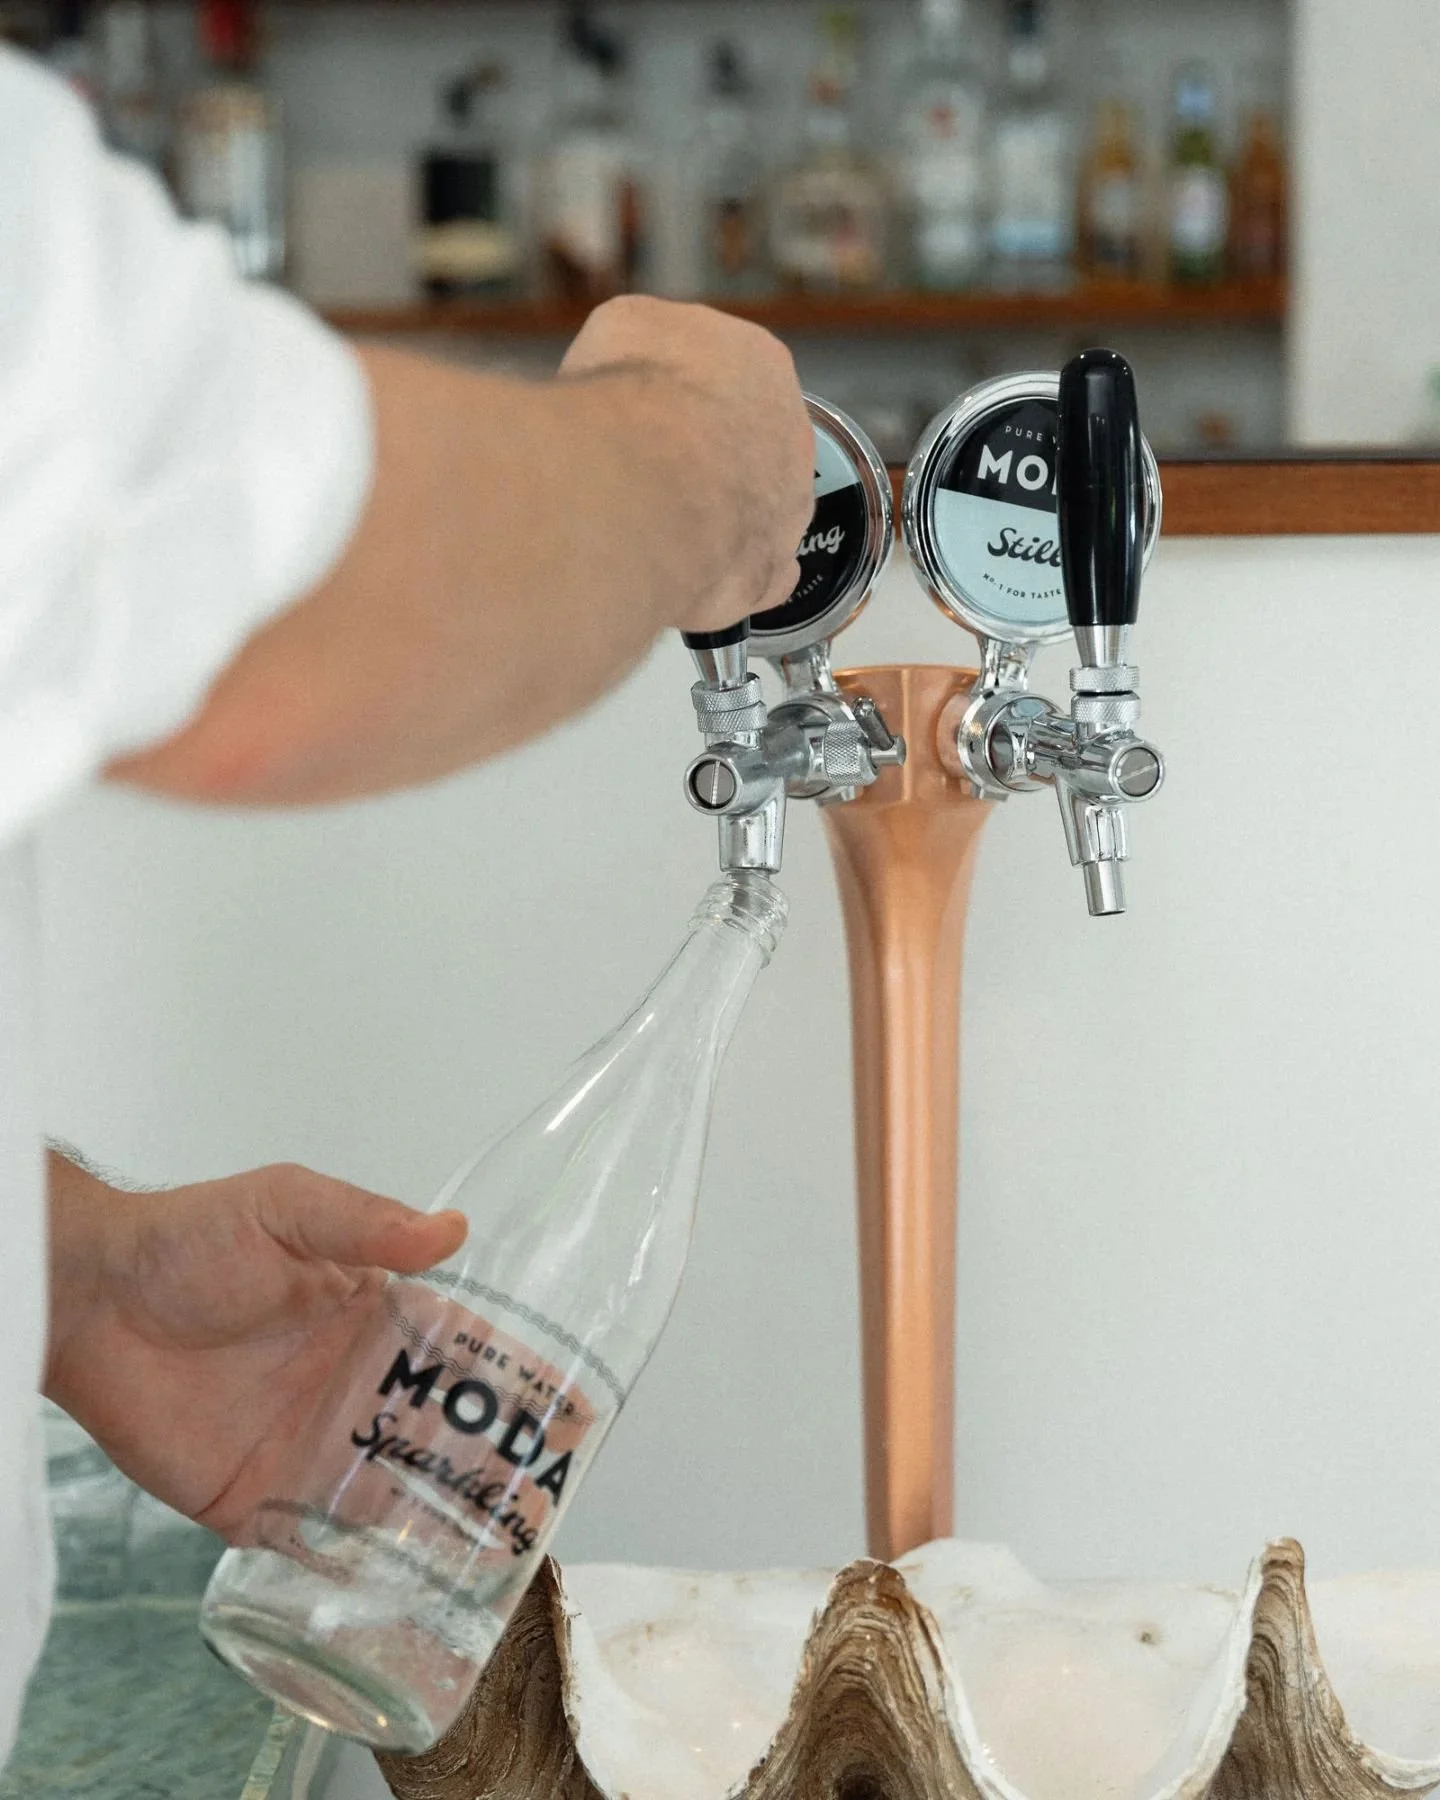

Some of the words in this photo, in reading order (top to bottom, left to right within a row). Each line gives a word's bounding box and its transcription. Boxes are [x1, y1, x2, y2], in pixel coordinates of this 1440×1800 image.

[1005, 425, 1043, 442] PURE
[977, 444, 1057, 496] MO
[1006, 587, 1026, 598] FOR
[454, 1331, 509, 1370] PURE
[518, 1364, 575, 1417] WATER
[377, 1347, 573, 1508] MODA
